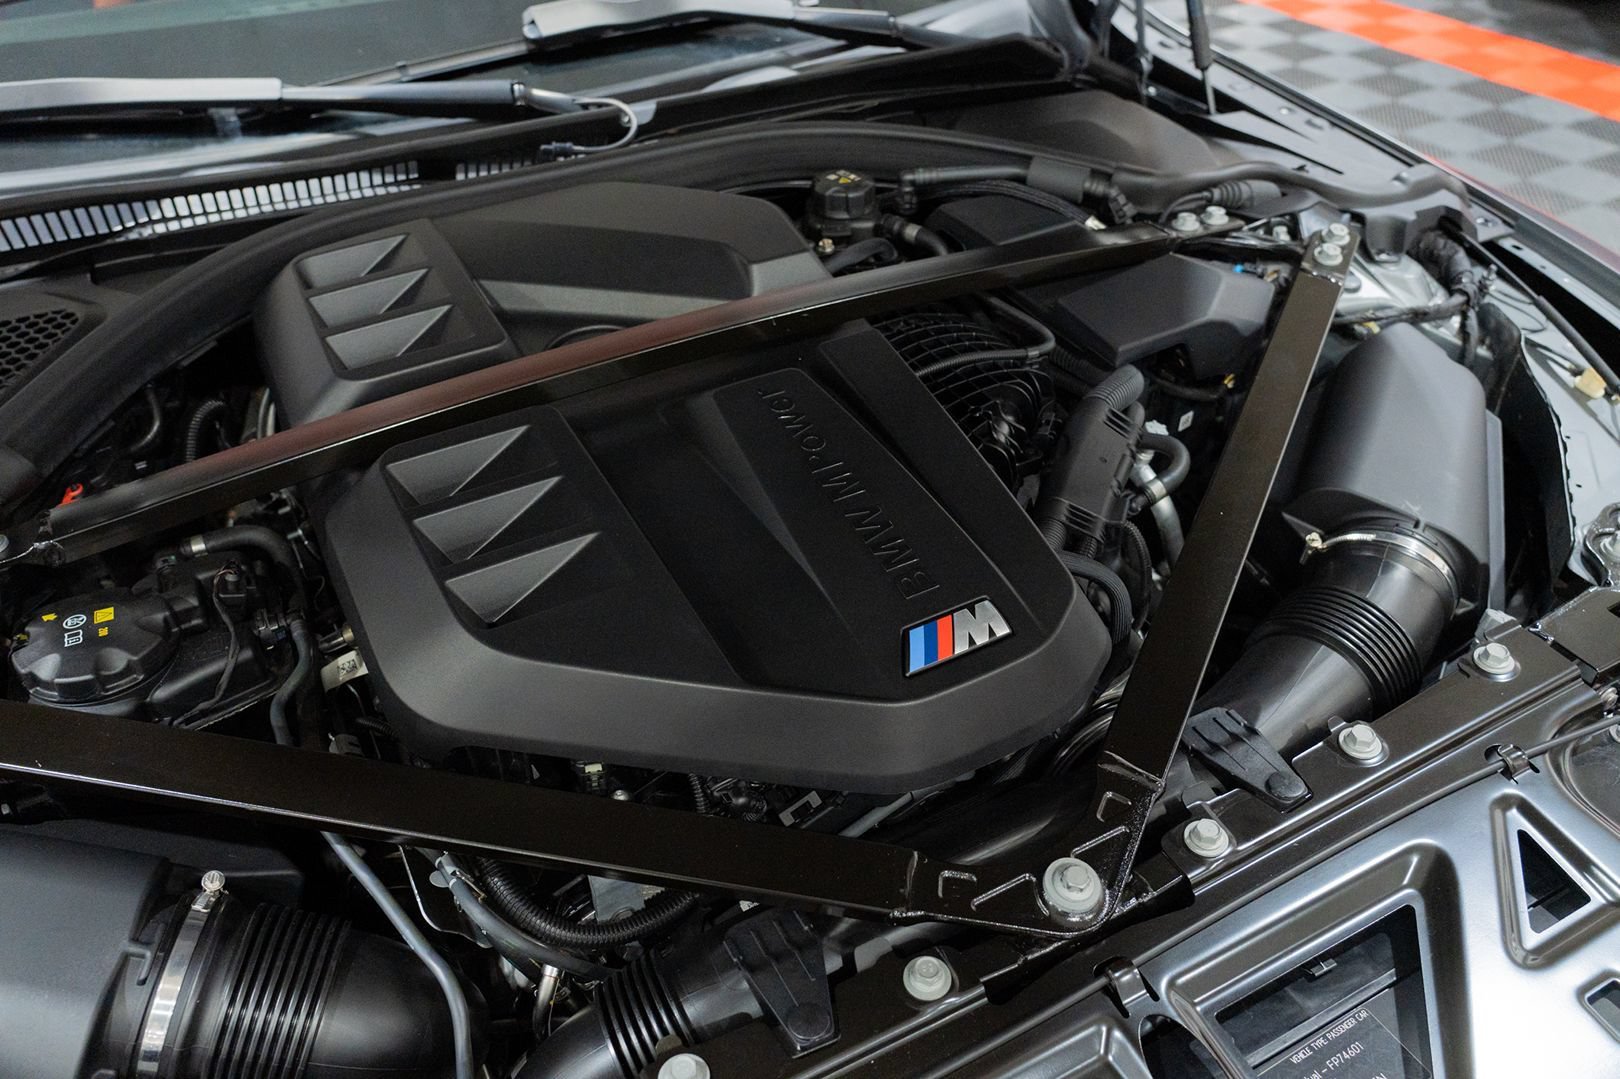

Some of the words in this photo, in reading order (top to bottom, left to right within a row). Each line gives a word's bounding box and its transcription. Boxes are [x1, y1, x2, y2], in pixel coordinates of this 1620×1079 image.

[757, 389, 845, 474] Power
[821, 472, 867, 503] M
[845, 504, 940, 600] BMW
[953, 599, 1012, 655] M
[1289, 1047, 1313, 1064] VEHICLE
[1325, 1017, 1358, 1041] PASSENGER
[1355, 1009, 1369, 1021] CAR
[1326, 1041, 1365, 1071] FP74601
